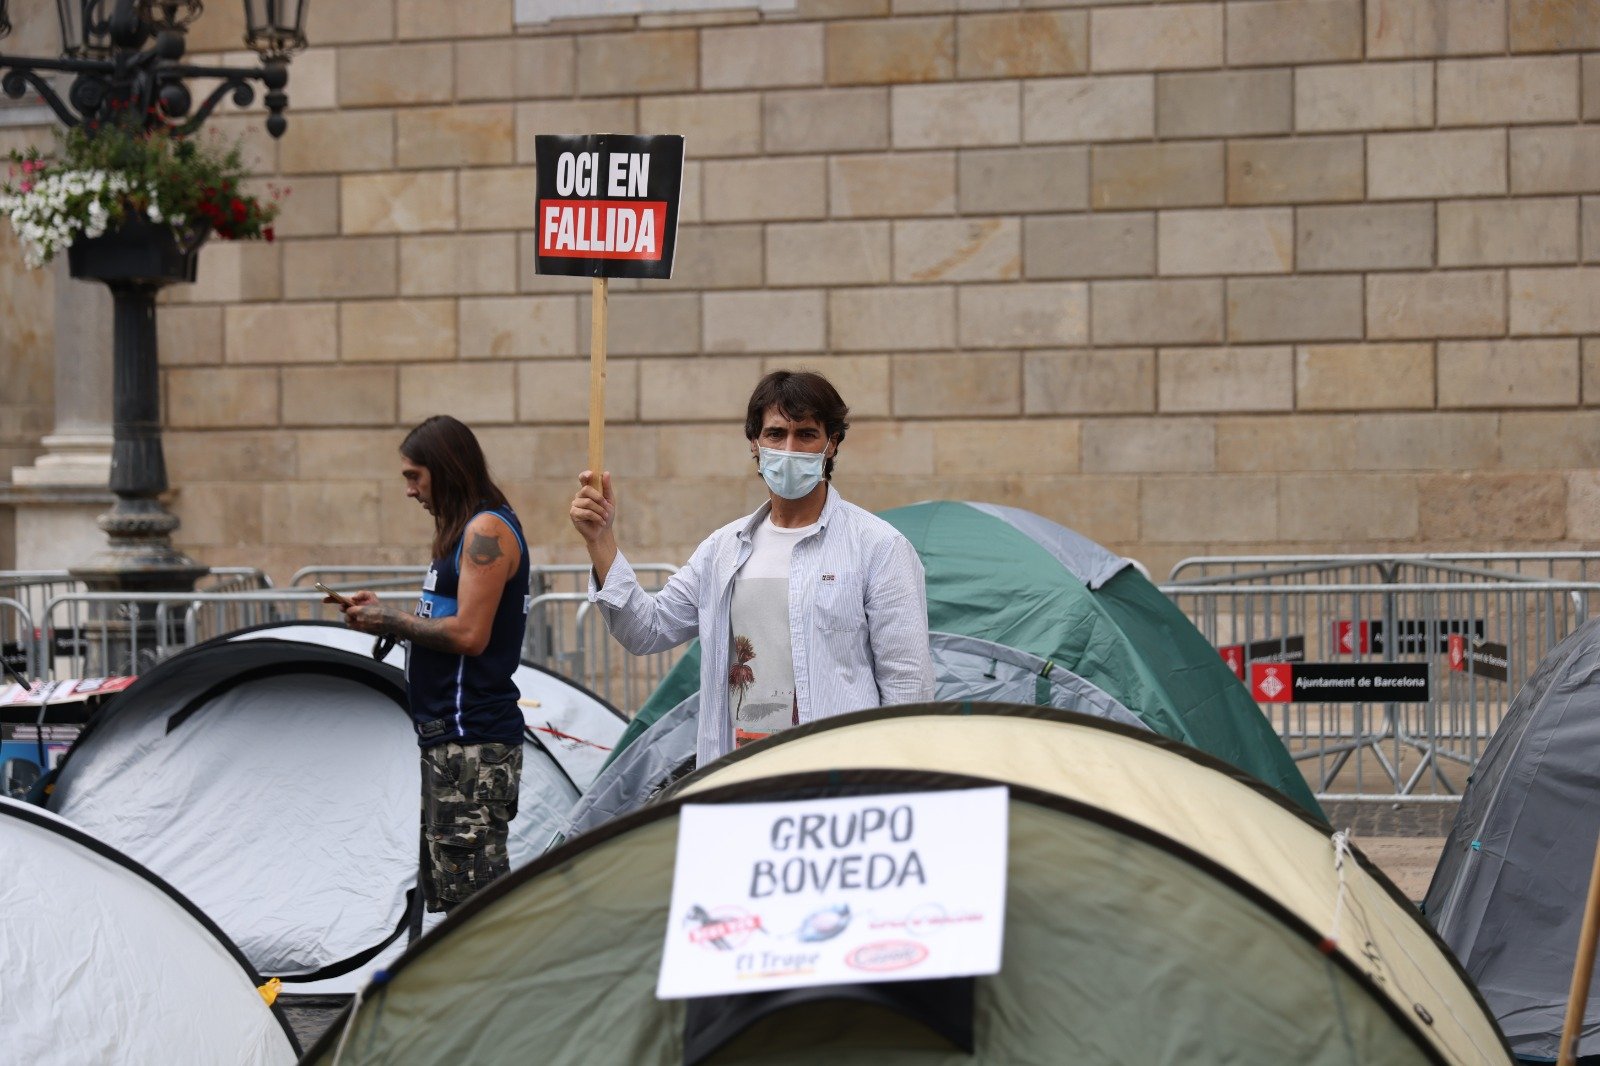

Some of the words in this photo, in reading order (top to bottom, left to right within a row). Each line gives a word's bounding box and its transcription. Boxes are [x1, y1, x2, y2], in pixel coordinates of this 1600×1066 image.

[556, 151, 600, 197] OCI
[607, 152, 651, 198] EN
[544, 206, 656, 253] FALLIDA
[1295, 676, 1356, 690] Ajuntament
[1357, 676, 1372, 688] de
[1373, 676, 1426, 688] Barcelona
[770, 805, 915, 851] GRUPO
[748, 850, 927, 899] BOVEDA
